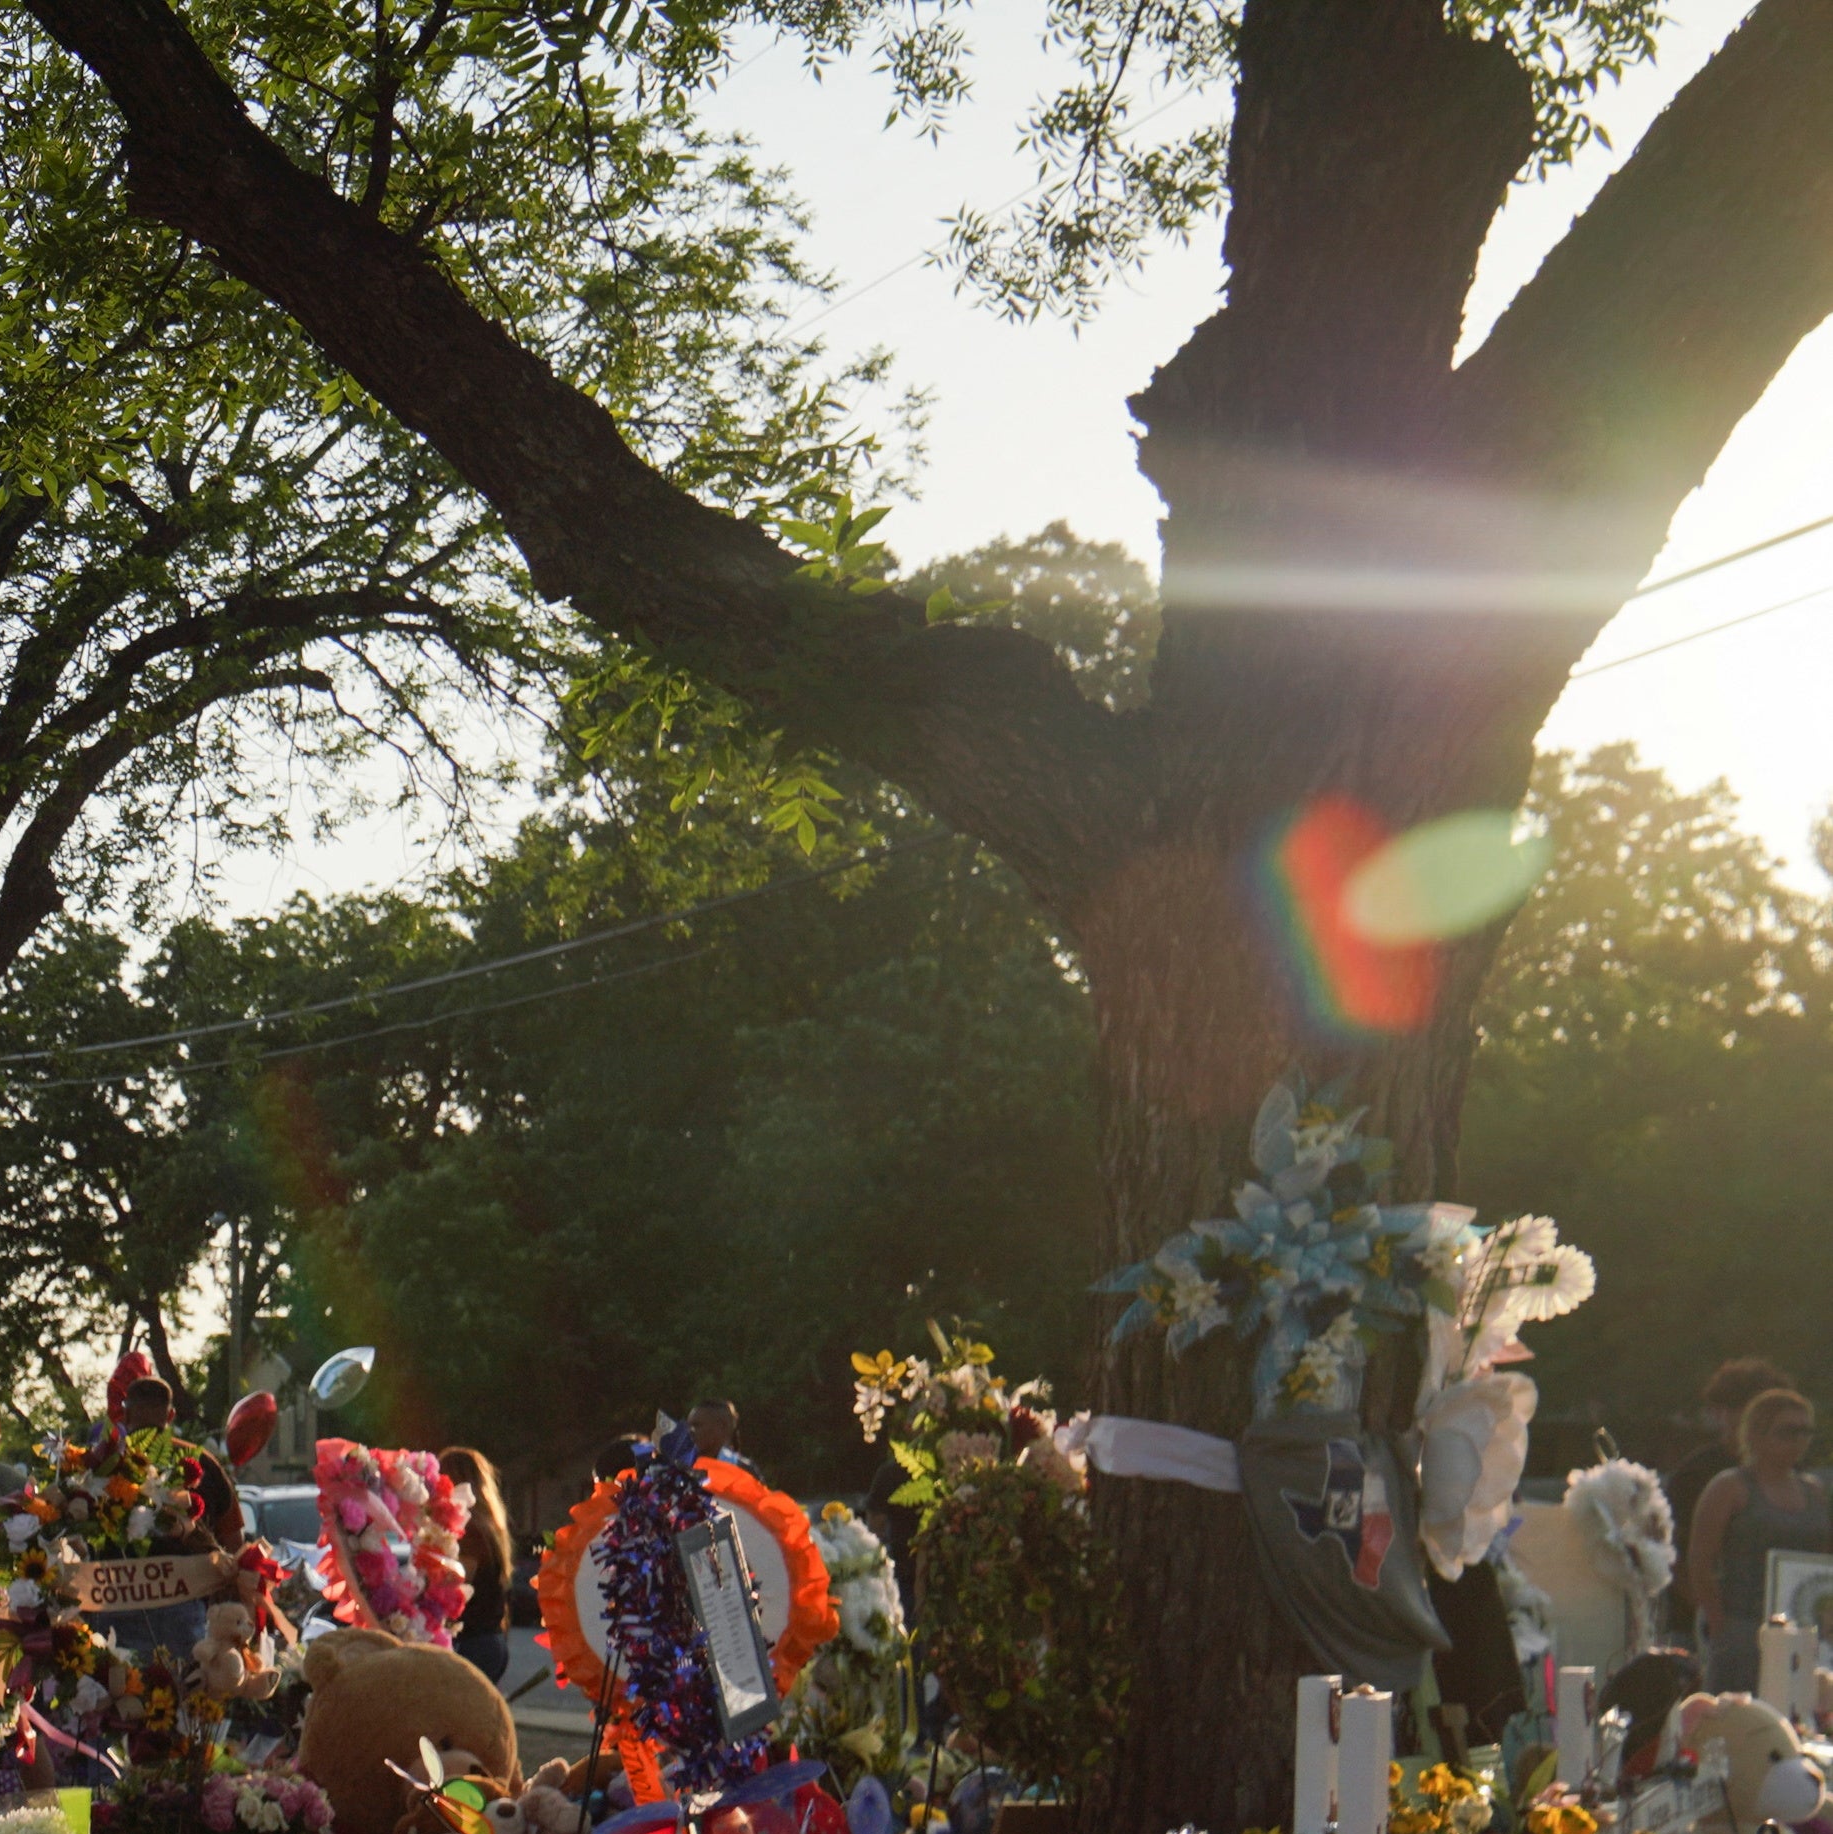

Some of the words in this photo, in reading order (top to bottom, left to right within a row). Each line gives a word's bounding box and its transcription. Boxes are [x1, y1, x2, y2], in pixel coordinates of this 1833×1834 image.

[93, 1564, 136, 1584] CITY
[144, 1561, 174, 1580] OF
[90, 1578, 190, 1604] COTULLA
